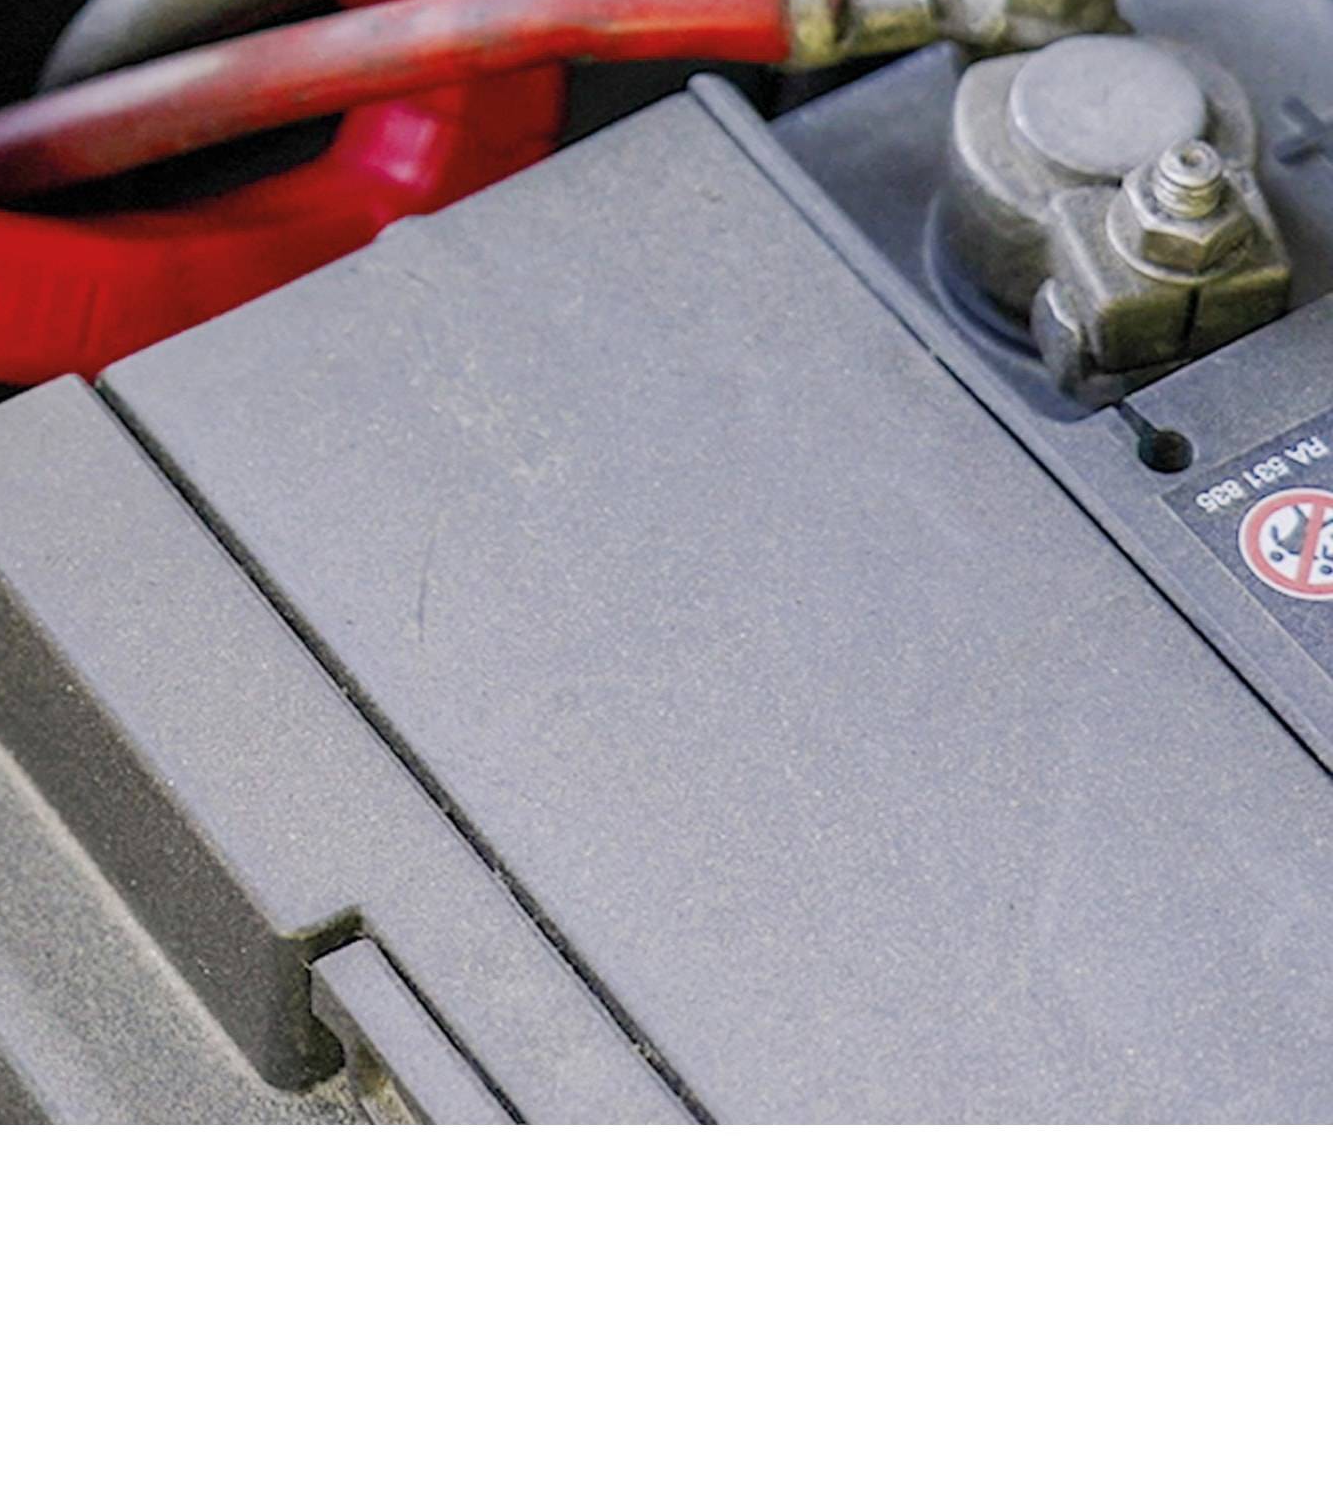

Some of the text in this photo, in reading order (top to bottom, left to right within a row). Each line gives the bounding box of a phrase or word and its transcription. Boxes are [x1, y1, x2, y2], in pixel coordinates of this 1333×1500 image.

[1196, 435, 1332, 514] RA 531 835
